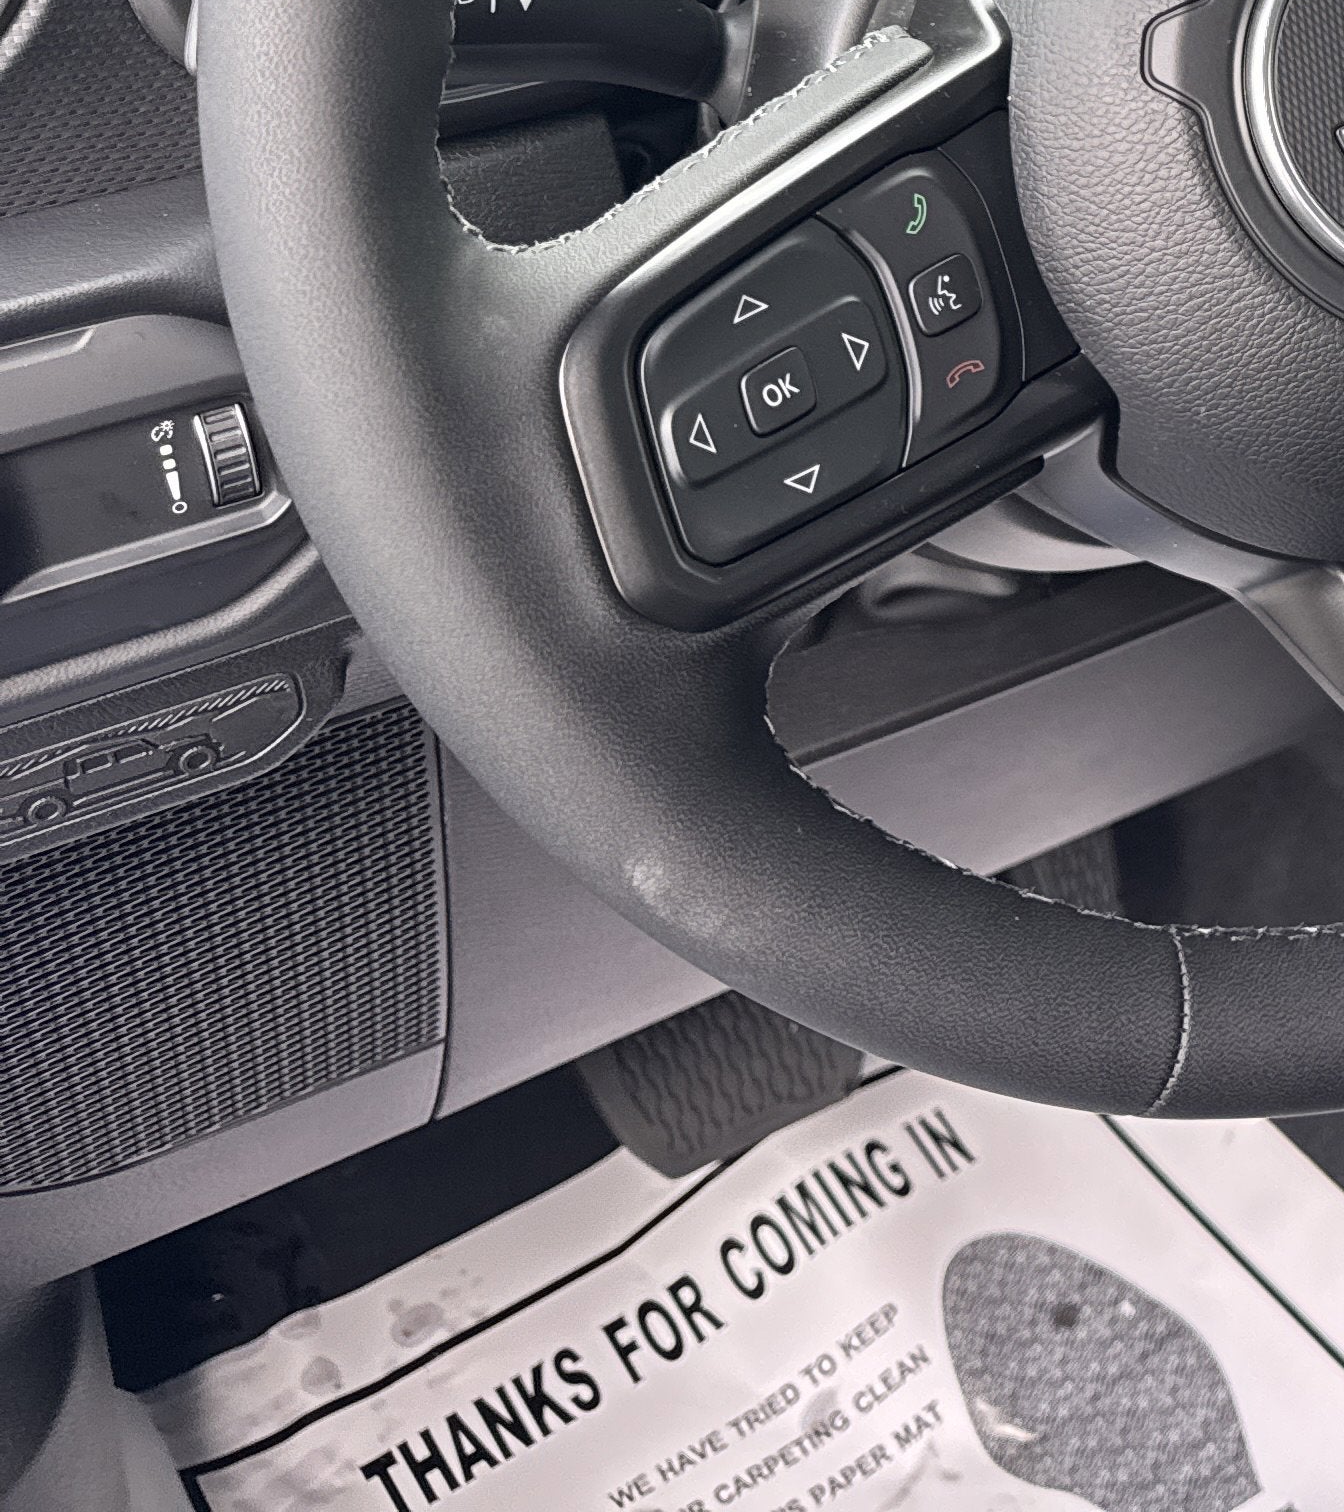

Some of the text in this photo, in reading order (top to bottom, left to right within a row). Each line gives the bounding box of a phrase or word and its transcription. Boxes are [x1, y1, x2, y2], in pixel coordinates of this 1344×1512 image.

[762, 373, 800, 407] OK
[360, 1107, 978, 1512] THANKS FOR COMING IN
[608, 1302, 899, 1509] WE HAVE TRIED TO KEEP
[713, 1343, 932, 1505] CARPETING CLEAN
[807, 1400, 945, 1508] PAPER MAT
